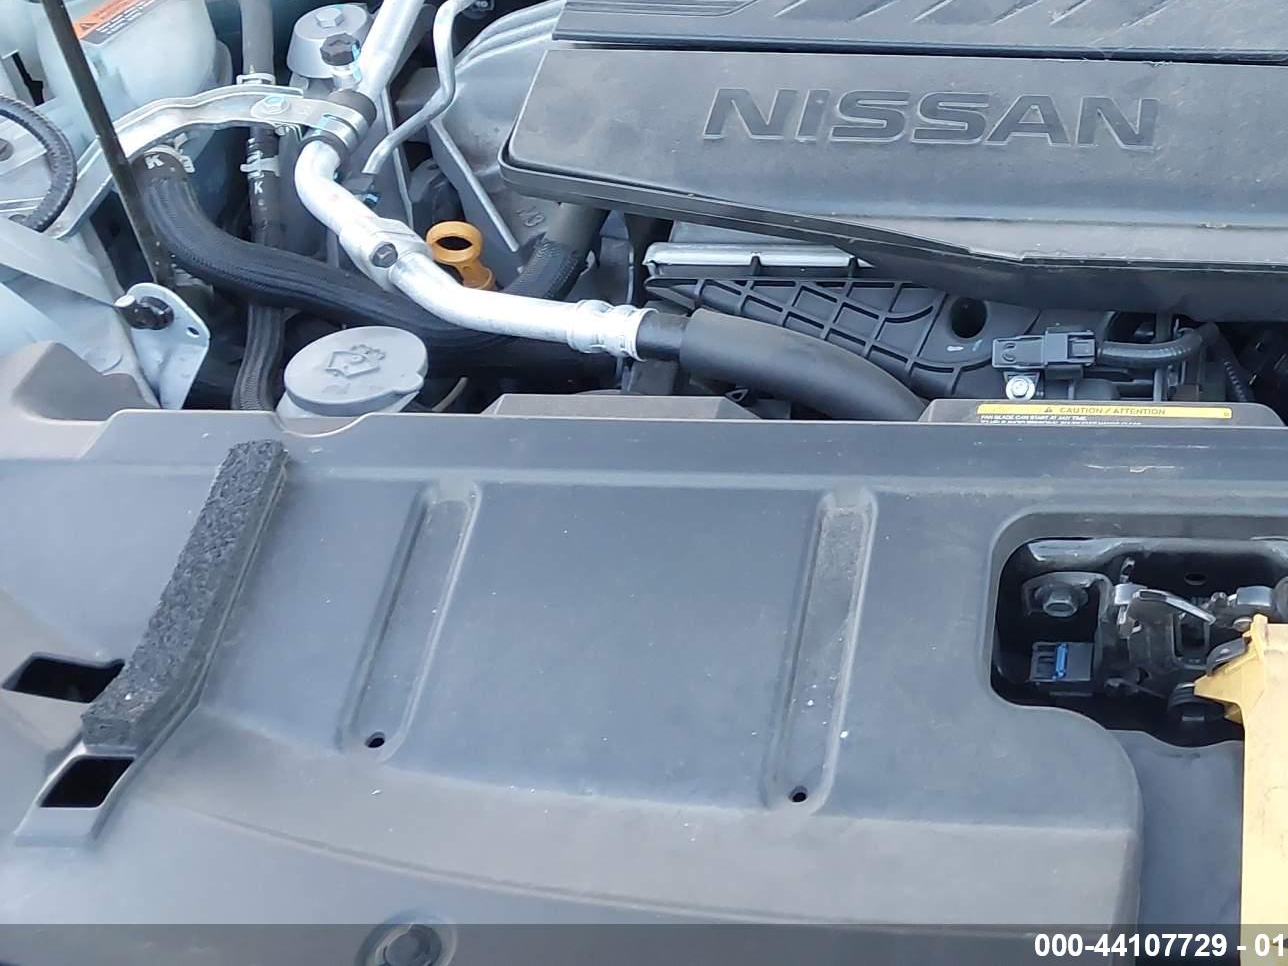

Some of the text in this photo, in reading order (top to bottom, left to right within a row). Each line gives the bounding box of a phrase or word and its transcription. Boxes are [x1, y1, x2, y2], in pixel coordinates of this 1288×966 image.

[702, 87, 1161, 152] NISSAN
[254, 180, 264, 195] K
[1059, 407, 1103, 415] CAUTION
[1112, 408, 1166, 416] ATTENTION
